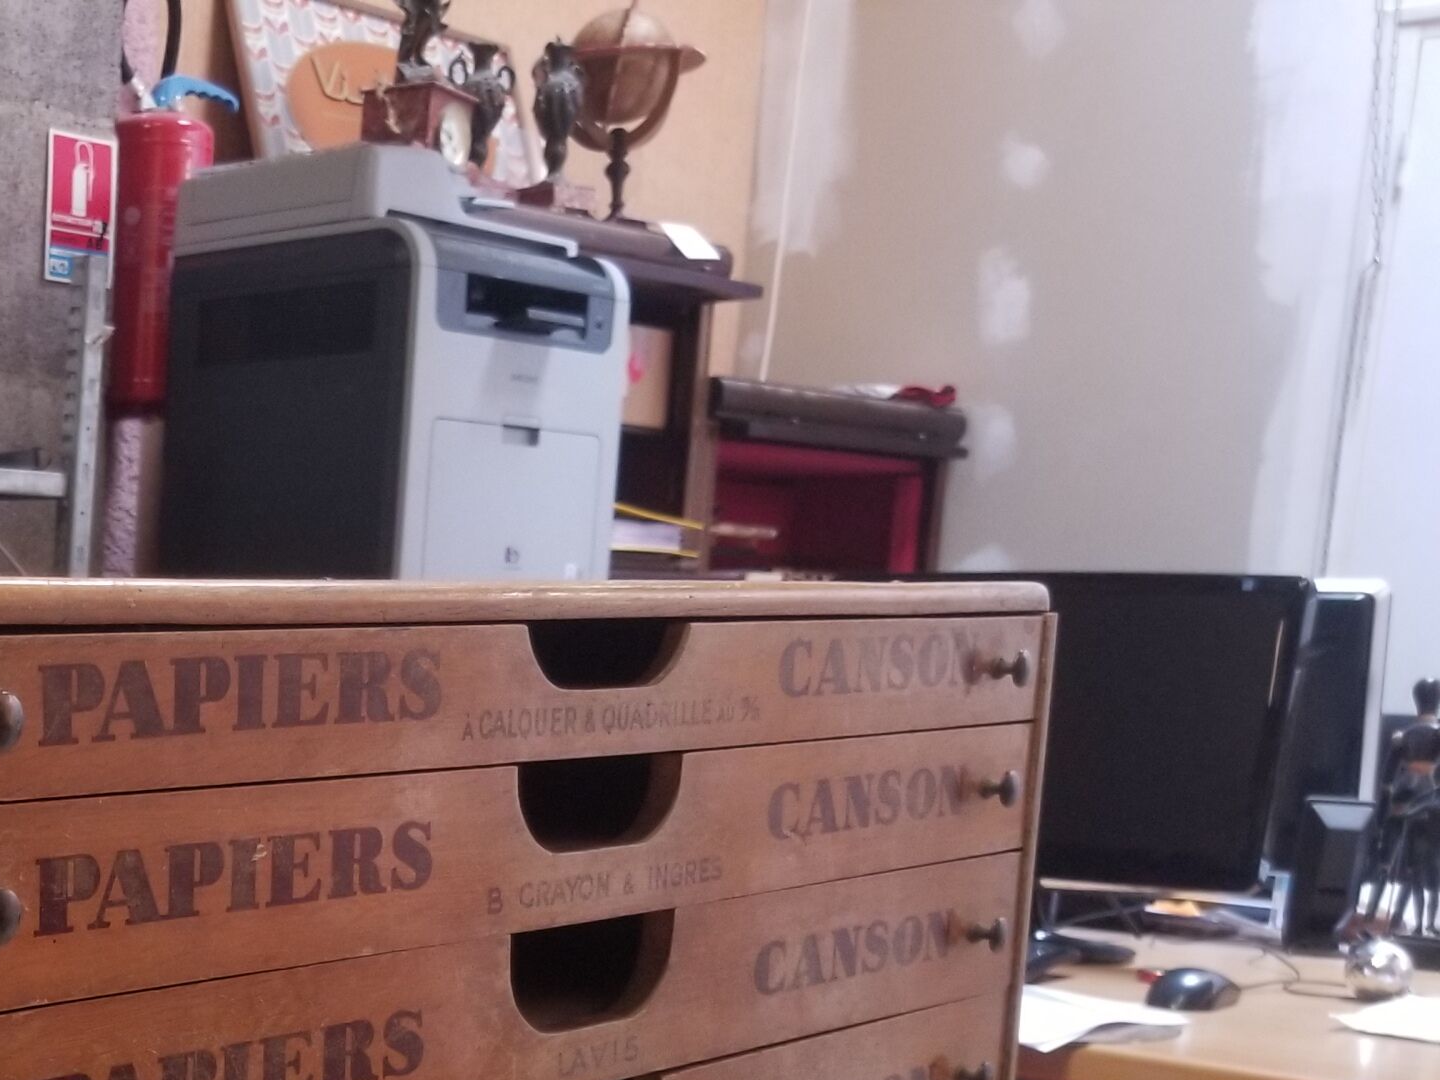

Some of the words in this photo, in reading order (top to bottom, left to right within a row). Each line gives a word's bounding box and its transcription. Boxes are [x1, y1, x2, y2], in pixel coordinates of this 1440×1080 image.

[38, 648, 442, 746] PAPIERS
[778, 625, 979, 698] CANSON
[478, 706, 578, 741] CALQUER
[33, 821, 433, 938] PAPIERS
[767, 764, 967, 842] CANSON
[487, 887, 504, 915] B
[518, 873, 611, 909] CRAYON
[647, 857, 724, 891] INGRES
[753, 908, 957, 997] CANSON
